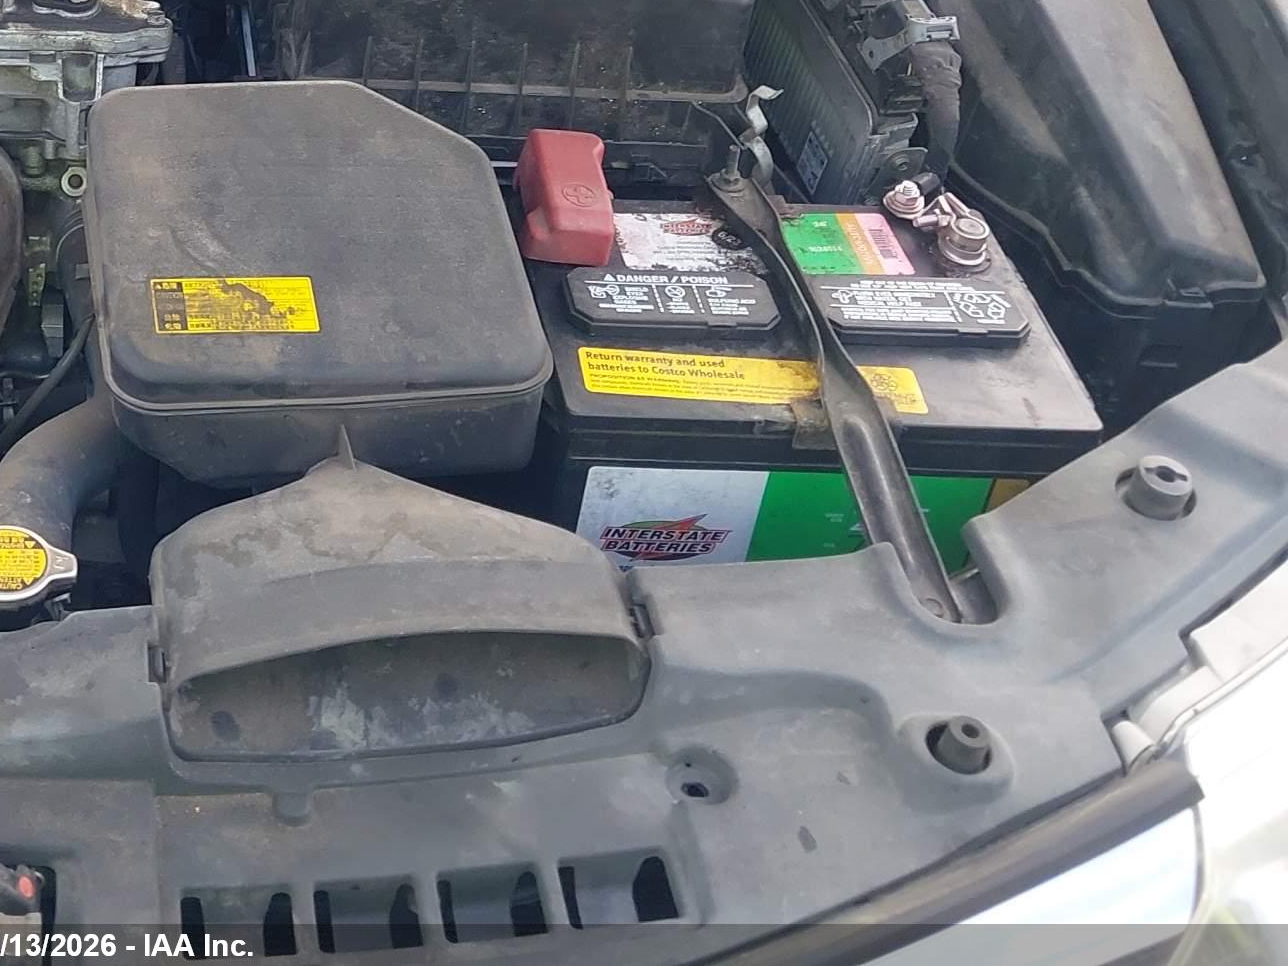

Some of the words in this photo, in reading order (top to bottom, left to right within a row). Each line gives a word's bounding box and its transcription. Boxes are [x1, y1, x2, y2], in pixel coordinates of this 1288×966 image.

[616, 274, 669, 283] DANGER
[679, 275, 728, 284] POISON
[585, 351, 623, 361] Return
[625, 355, 673, 366] warranty
[676, 358, 696, 367] and
[699, 359, 725, 368] used
[588, 361, 636, 373] batteries
[639, 365, 650, 374] to
[651, 366, 686, 377] Costco
[688, 369, 745, 380] Wholesale
[604, 528, 725, 541] INTERSTATE
[605, 540, 712, 553] BATTERIES
